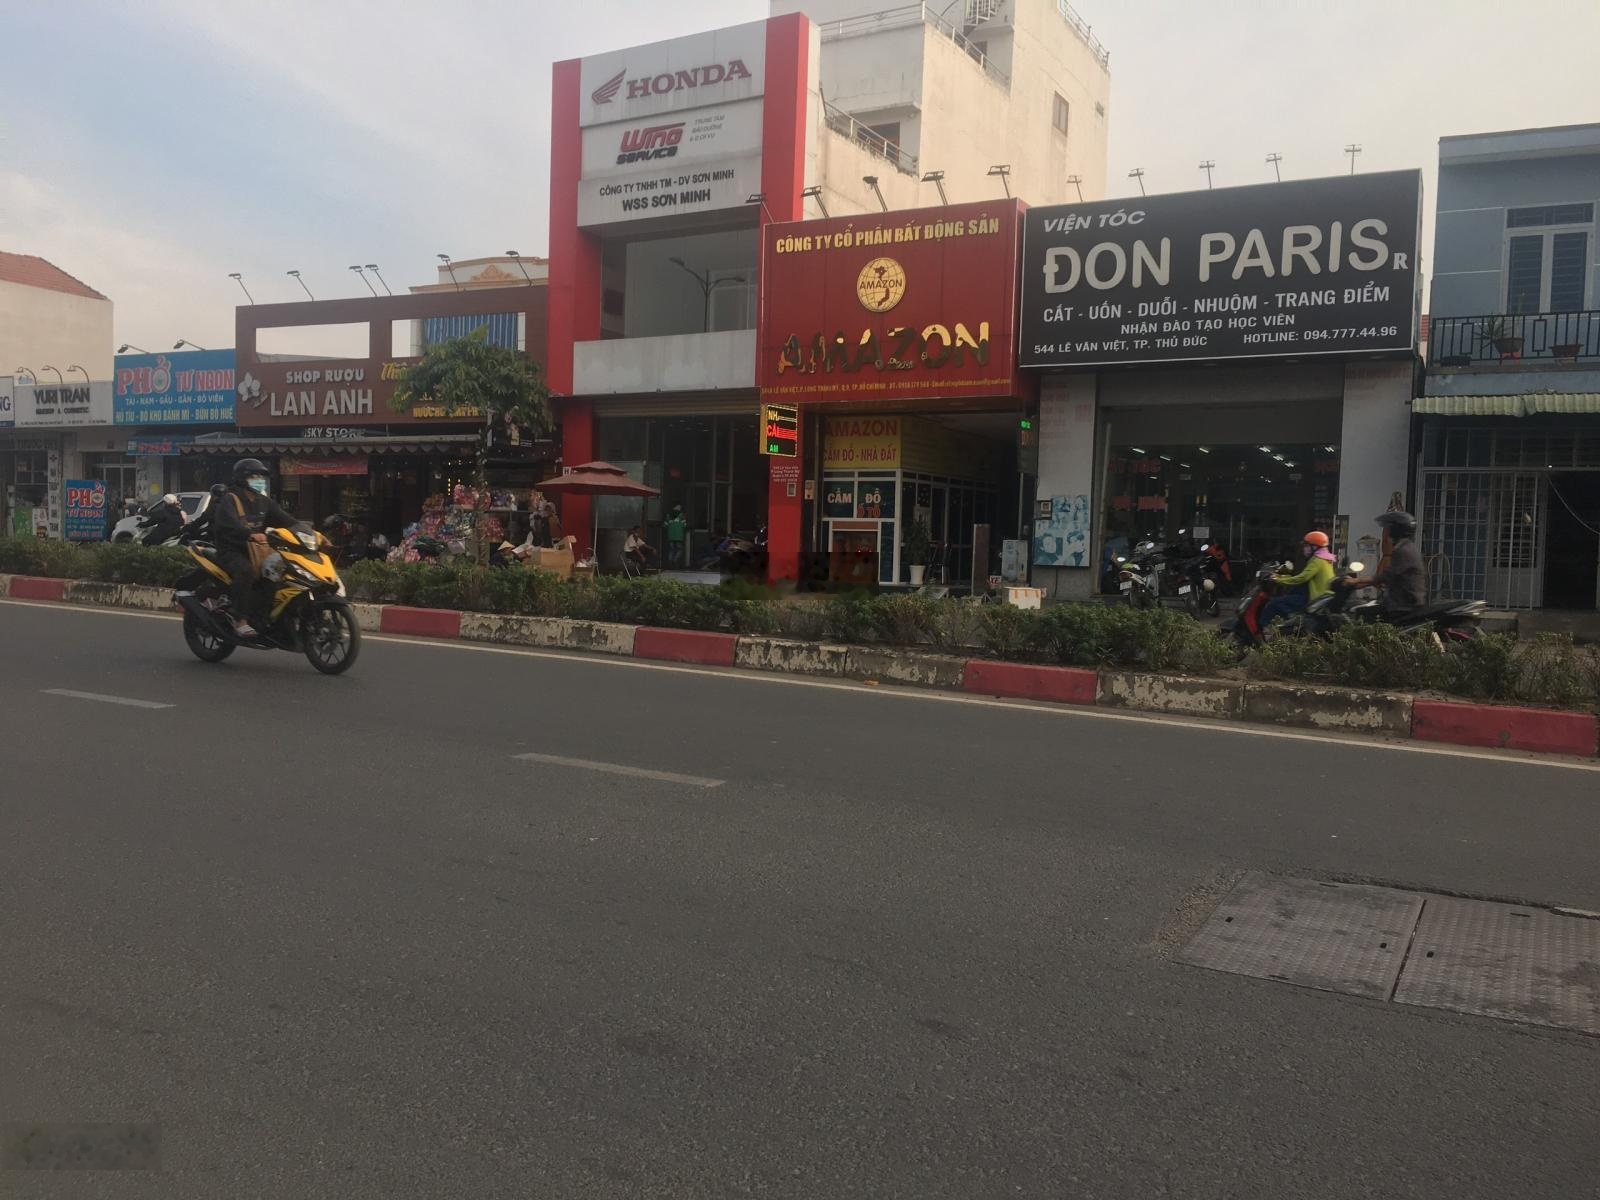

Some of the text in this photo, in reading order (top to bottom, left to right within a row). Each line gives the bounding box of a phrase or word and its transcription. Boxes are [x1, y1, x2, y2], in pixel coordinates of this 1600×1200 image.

[626, 59, 752, 100] HONDA
[616, 146, 678, 164] SERVICE
[599, 182, 622, 196] CÔNG
[623, 183, 634, 193] TY
[636, 179, 658, 192] TNHH
[660, 177, 672, 190] TM
[678, 174, 691, 186] DV
[692, 170, 711, 184] SƠN
[713, 169, 735, 182] MINH
[622, 189, 711, 212] WSS SƠN MINH
[776, 212, 999, 254] CÔNG TY CỔ PHẦN BẤT ĐỘNG SẢN
[1043, 207, 1146, 236] VIỆN TÓC
[1043, 236, 1171, 294] ĐON
[1199, 218, 1389, 282] PARIS
[859, 278, 903, 290] AMAZON
[1043, 301, 1074, 323] CẮT
[1088, 299, 1122, 320] UỐN
[1137, 295, 1178, 318] DUỖI
[1193, 293, 1257, 318] NHUỘM
[1275, 288, 1336, 309] TRANG
[1343, 280, 1390, 305] ĐIỂM
[1120, 311, 1296, 336] NHẬN ĐÀO TẠO HỌC VIÊN
[1243, 325, 1398, 345] HOTLINE: 094.777.44.96
[777, 321, 991, 375] AMAZON
[1033, 332, 1208, 355] 544 LÊ VĂN VIỆT, TP. THỦ ĐỨC
[117, 355, 171, 395] PHỞ
[195, 368, 235, 392] NGON
[286, 367, 364, 386] SHOP RƯỢU
[34, 387, 90, 404] YURI TRAN
[270, 389, 373, 416] LAN ANH
[150, 410, 162, 422] KHO
[824, 419, 897, 437] AMAZON
[861, 444, 878, 462] NHÀ
[880, 442, 897, 461] ĐẤT
[67, 481, 105, 508] PHỞ
